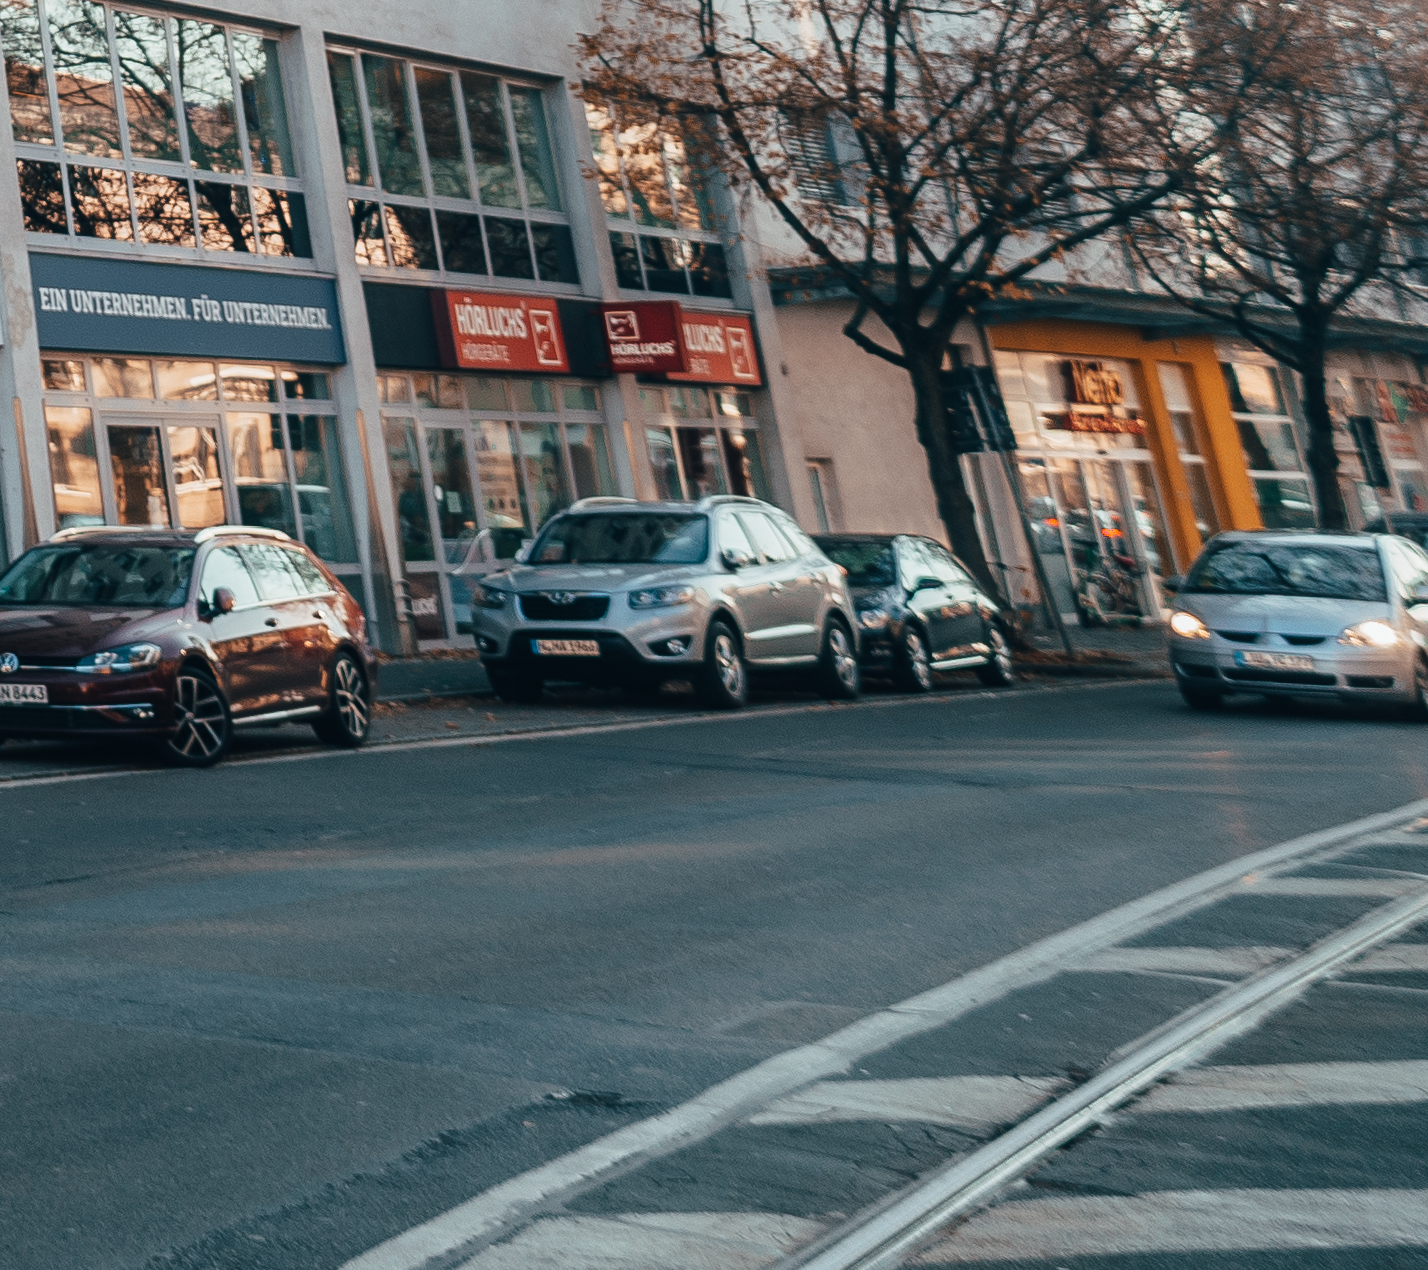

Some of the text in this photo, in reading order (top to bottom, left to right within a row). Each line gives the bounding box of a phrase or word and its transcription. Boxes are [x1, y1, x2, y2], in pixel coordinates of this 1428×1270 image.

[38, 287, 332, 329] EIN UNTERNEHMEN. FÜR UNTERNEHMEN.
[455, 297, 527, 339] HÖRLUCHS
